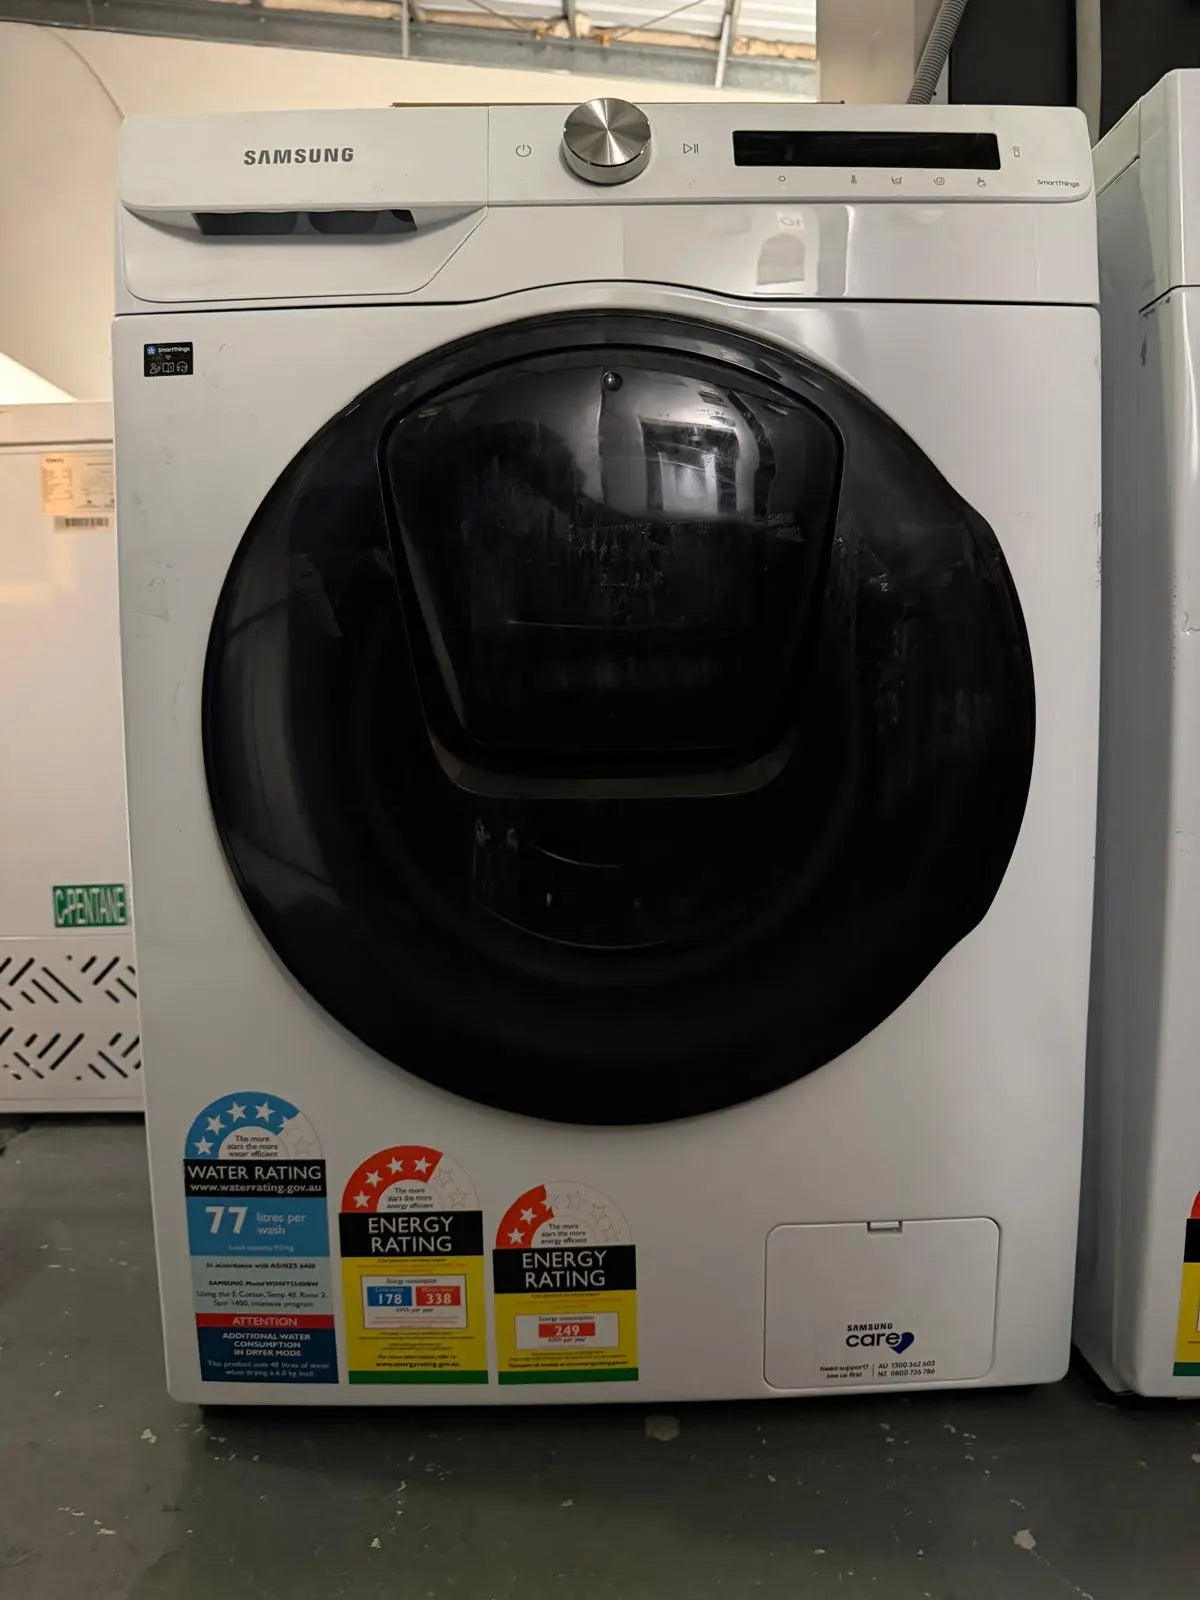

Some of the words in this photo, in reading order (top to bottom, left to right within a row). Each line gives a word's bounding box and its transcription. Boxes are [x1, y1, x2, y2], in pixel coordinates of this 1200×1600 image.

[244, 147, 354, 166] SAMSUNG
[1037, 179, 1080, 188] SmartThings
[235, 1135, 248, 1143] The
[187, 1165, 249, 1180] WATER
[254, 1165, 322, 1180] RATING
[190, 1182, 322, 1194] www.waterrating.gov.au
[205, 1205, 248, 1235] 77
[256, 1212, 285, 1223] litres
[287, 1213, 307, 1225] per
[255, 1224, 286, 1235] wash
[368, 1215, 454, 1235] ENERGY
[371, 1235, 452, 1253] RATING
[522, 1249, 608, 1269] ENERGY
[525, 1270, 606, 1289] RATING
[218, 1290, 230, 1298] the
[378, 1293, 403, 1305] 178
[425, 1293, 453, 1305] 338
[231, 1316, 298, 1327] ATTENTION
[847, 1322, 893, 1332] SAMSUNG
[222, 1332, 279, 1340] ADDITIONAL
[279, 1333, 311, 1341] WATER
[554, 1325, 580, 1337] 249
[233, 1341, 301, 1349] CONSUMPTION
[845, 1332, 900, 1348] care
[245, 1349, 274, 1357] DRYER
[839, 1364, 869, 1372] support?
